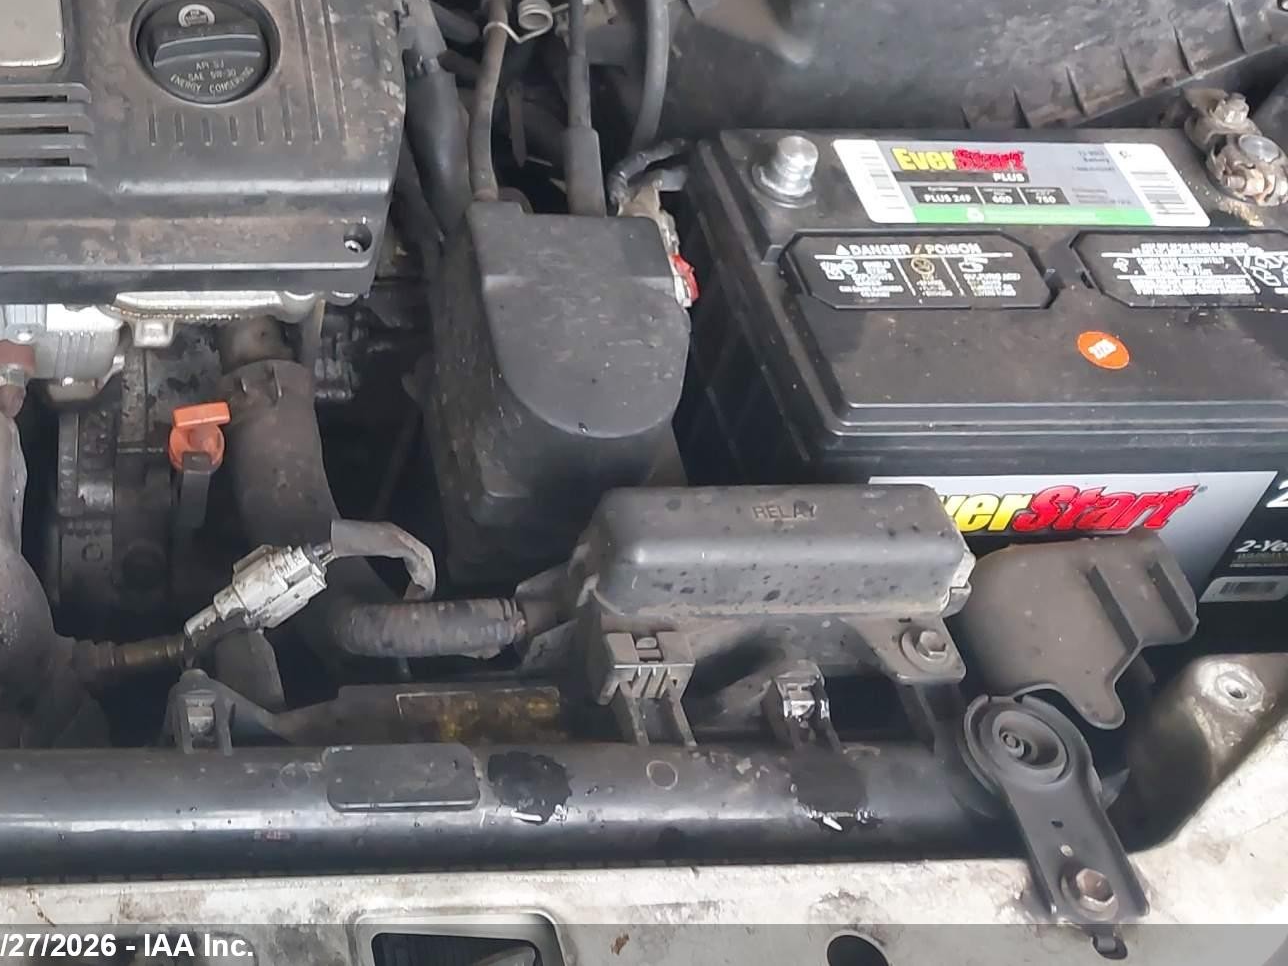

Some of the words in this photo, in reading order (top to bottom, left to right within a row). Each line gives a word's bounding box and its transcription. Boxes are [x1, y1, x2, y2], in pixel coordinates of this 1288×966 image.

[891, 146, 1027, 172] EverStart
[992, 172, 1025, 183] PLUS
[923, 193, 952, 204] PLUS
[849, 243, 911, 256] DANGER
[925, 243, 983, 255] POISON
[751, 501, 818, 519] RELAY
